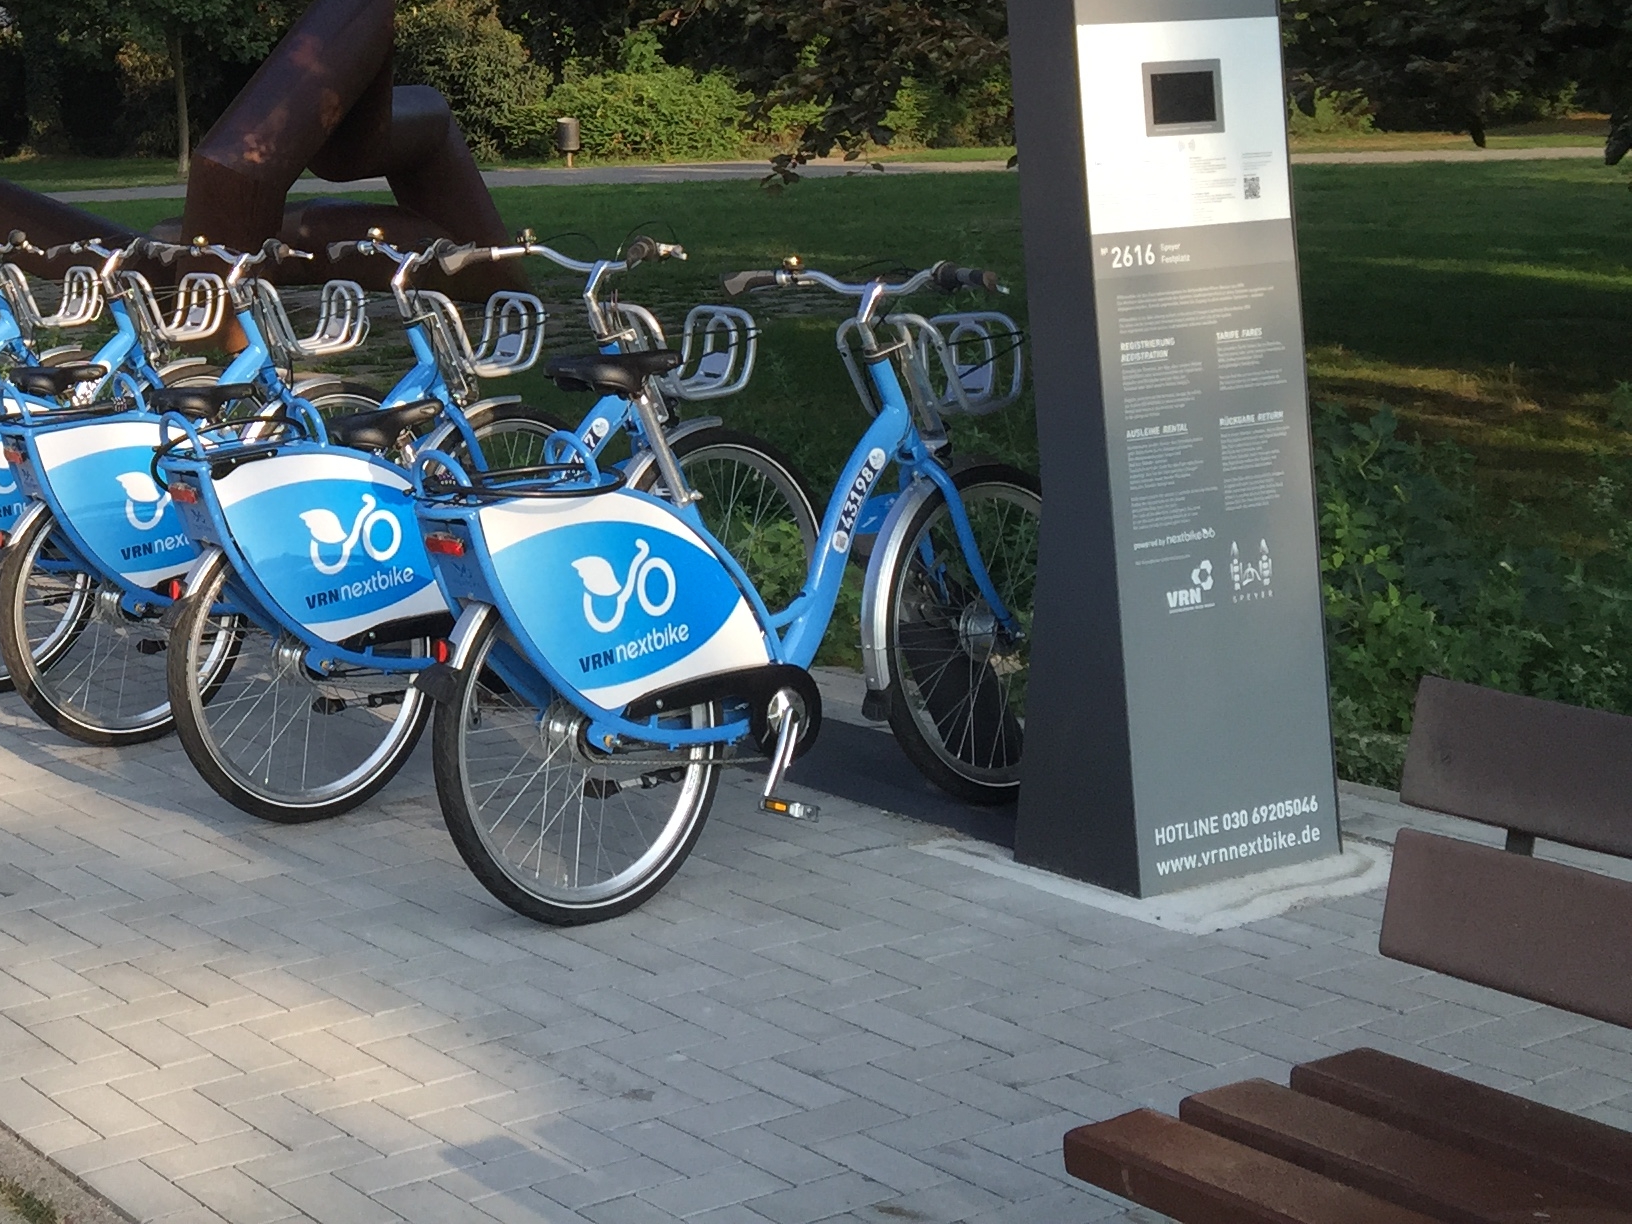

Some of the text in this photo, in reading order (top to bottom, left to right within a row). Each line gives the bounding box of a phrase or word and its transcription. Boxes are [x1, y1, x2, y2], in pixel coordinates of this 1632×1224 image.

[1111, 243, 1156, 269] 2616
[1120, 337, 1176, 351] REGISTRIERUNG
[1120, 349, 1169, 363] REGISTRATION
[1257, 411, 1284, 422] RETURN
[1126, 423, 1189, 438] AUSLEIHE RENTAL
[841, 467, 874, 530] 43198
[1166, 587, 1202, 608] VRN
[1154, 794, 1319, 846] HOTLINE 030 69205046
[1156, 824, 1321, 877] www.vrnnextbike.de
